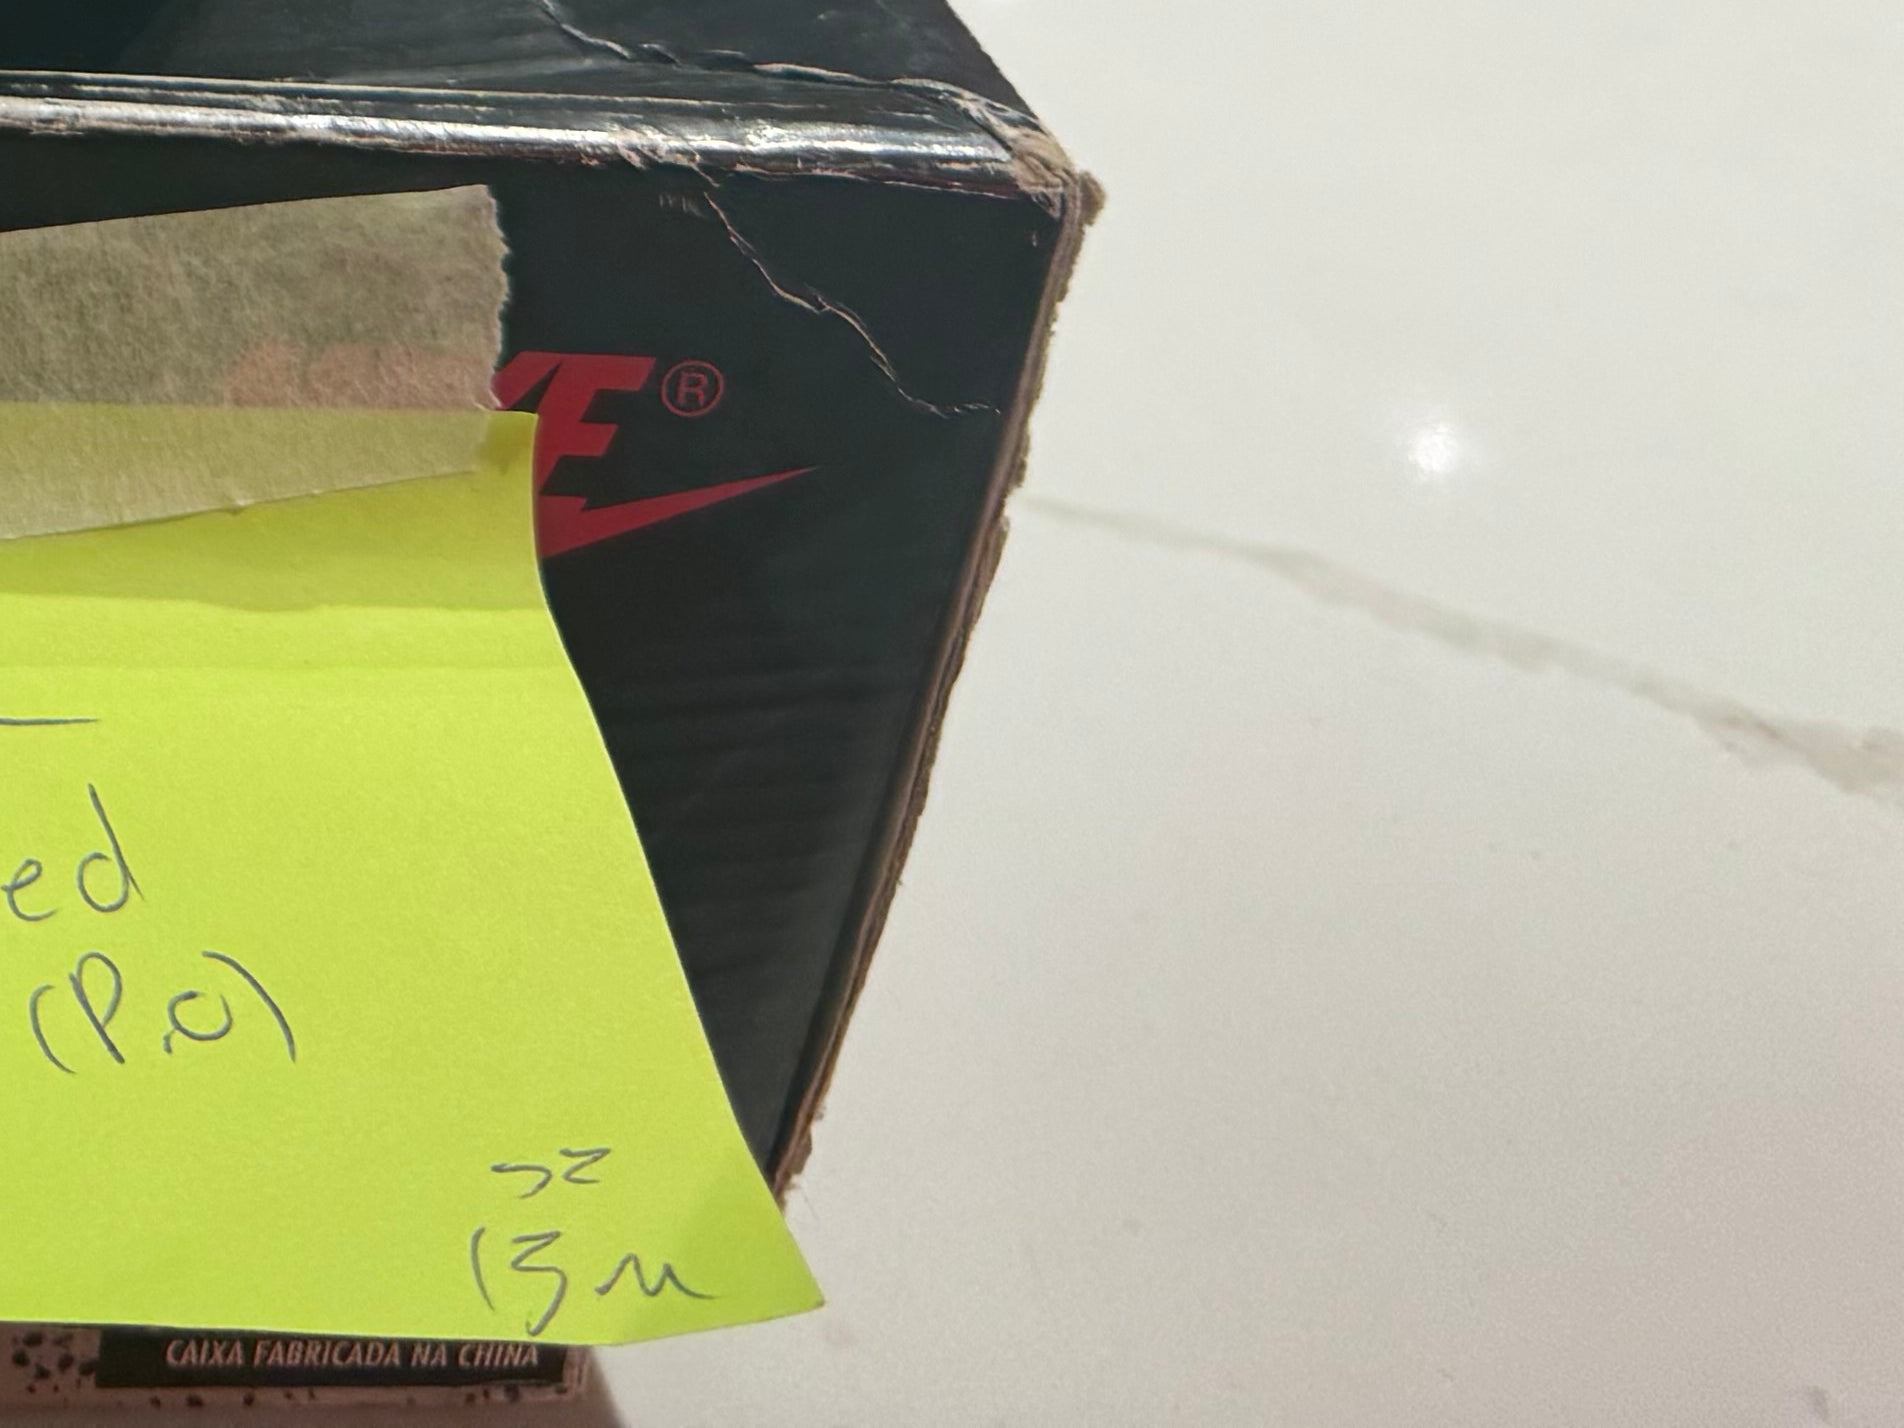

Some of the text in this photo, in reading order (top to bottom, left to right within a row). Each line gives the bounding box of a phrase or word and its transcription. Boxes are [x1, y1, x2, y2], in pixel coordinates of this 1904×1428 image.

[165, 1338, 539, 1369] CAIXA FABRICADA NA CHINA
